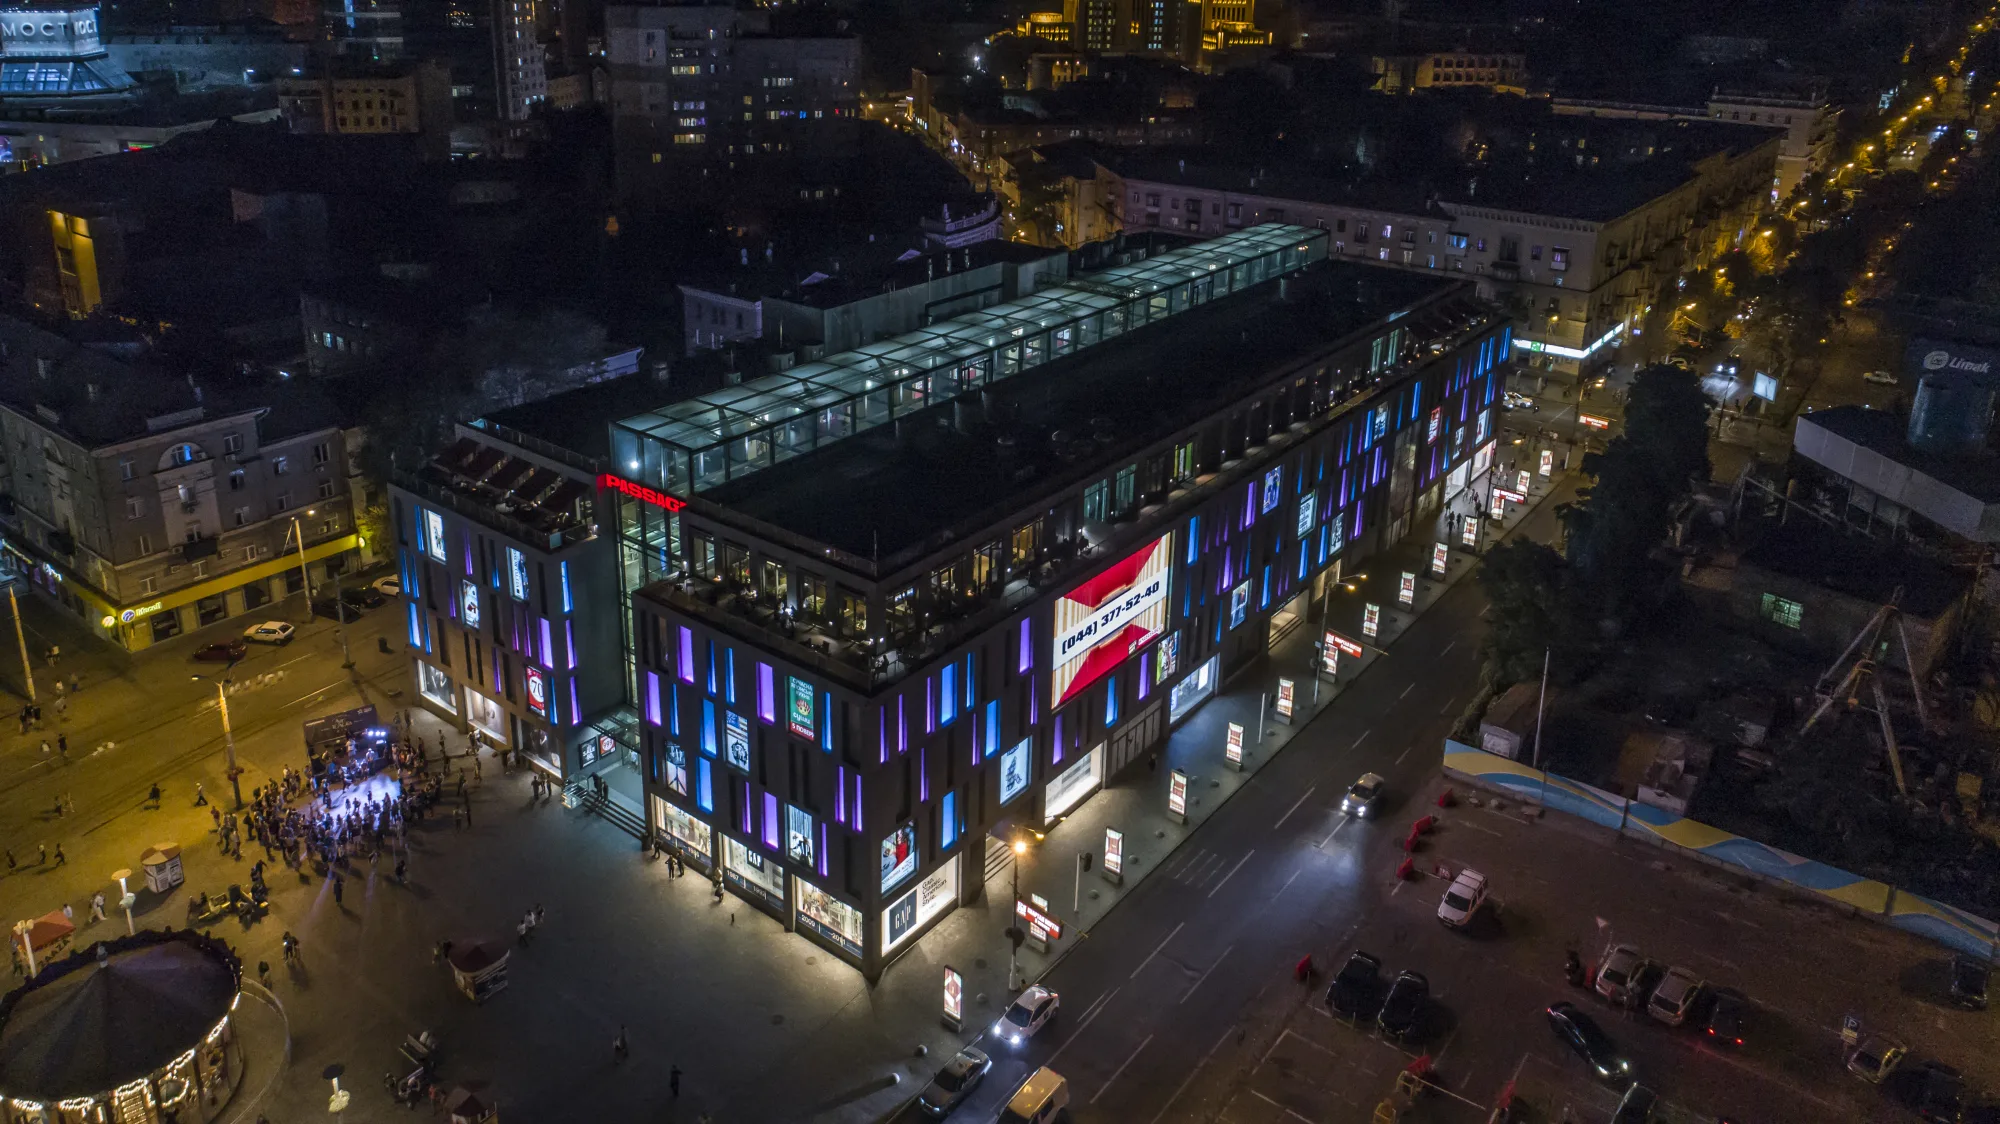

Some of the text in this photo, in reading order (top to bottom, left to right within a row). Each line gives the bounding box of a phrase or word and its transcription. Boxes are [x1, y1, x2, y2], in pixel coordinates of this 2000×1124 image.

[1101, 580, 1160, 627] 377-52-40
[748, 849, 762, 867] GAP
[922, 878, 947, 900] American
[895, 904, 911, 930] GAP
